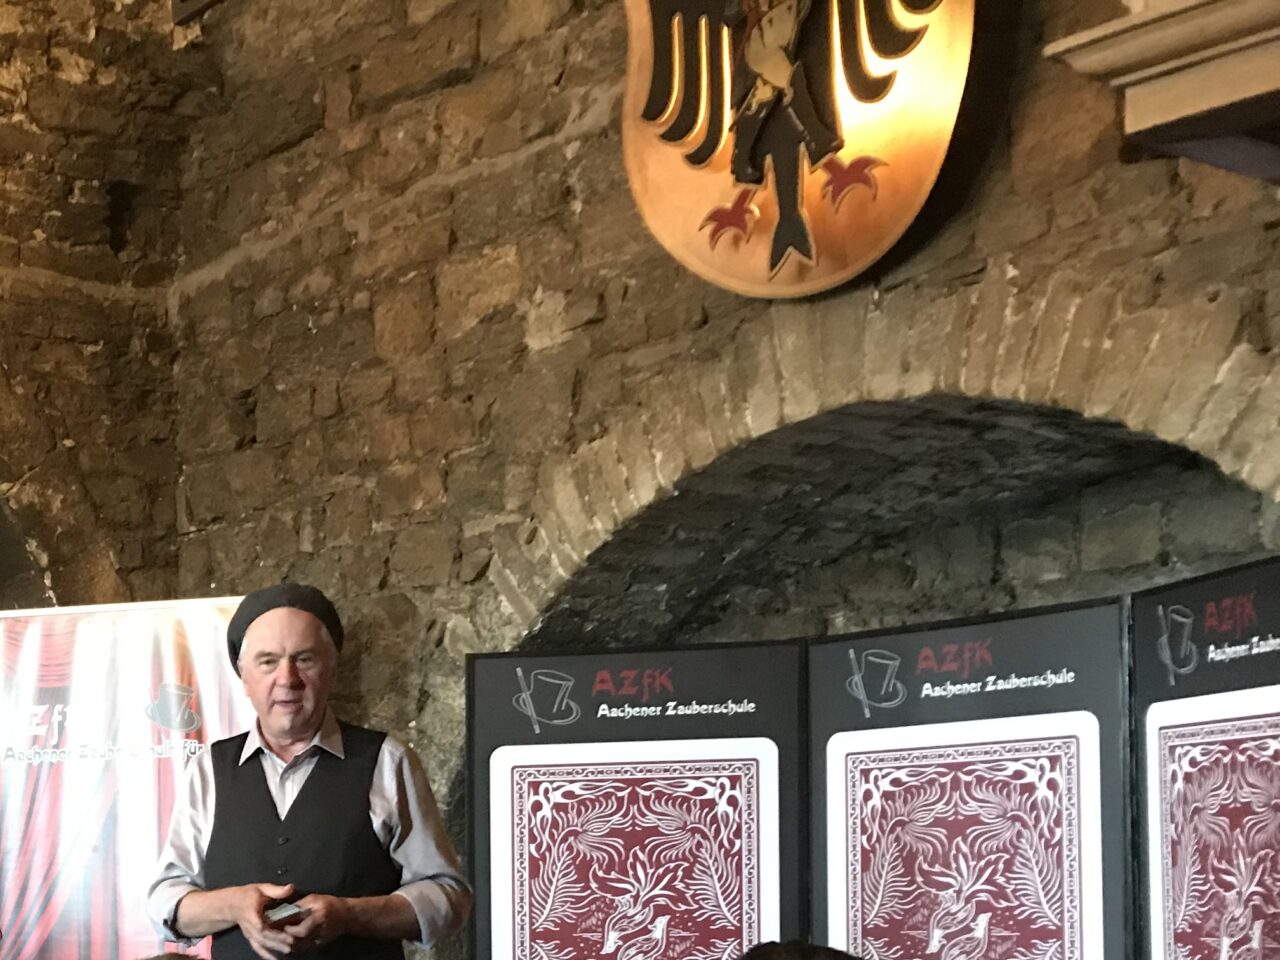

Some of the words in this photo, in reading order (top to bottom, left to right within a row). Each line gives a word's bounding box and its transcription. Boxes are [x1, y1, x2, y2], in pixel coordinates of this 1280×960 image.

[920, 680, 982, 699] Aachener
[984, 667, 1076, 692] Zauberschule
[596, 703, 662, 720] Aachener
[665, 698, 757, 716] Zauberschule
